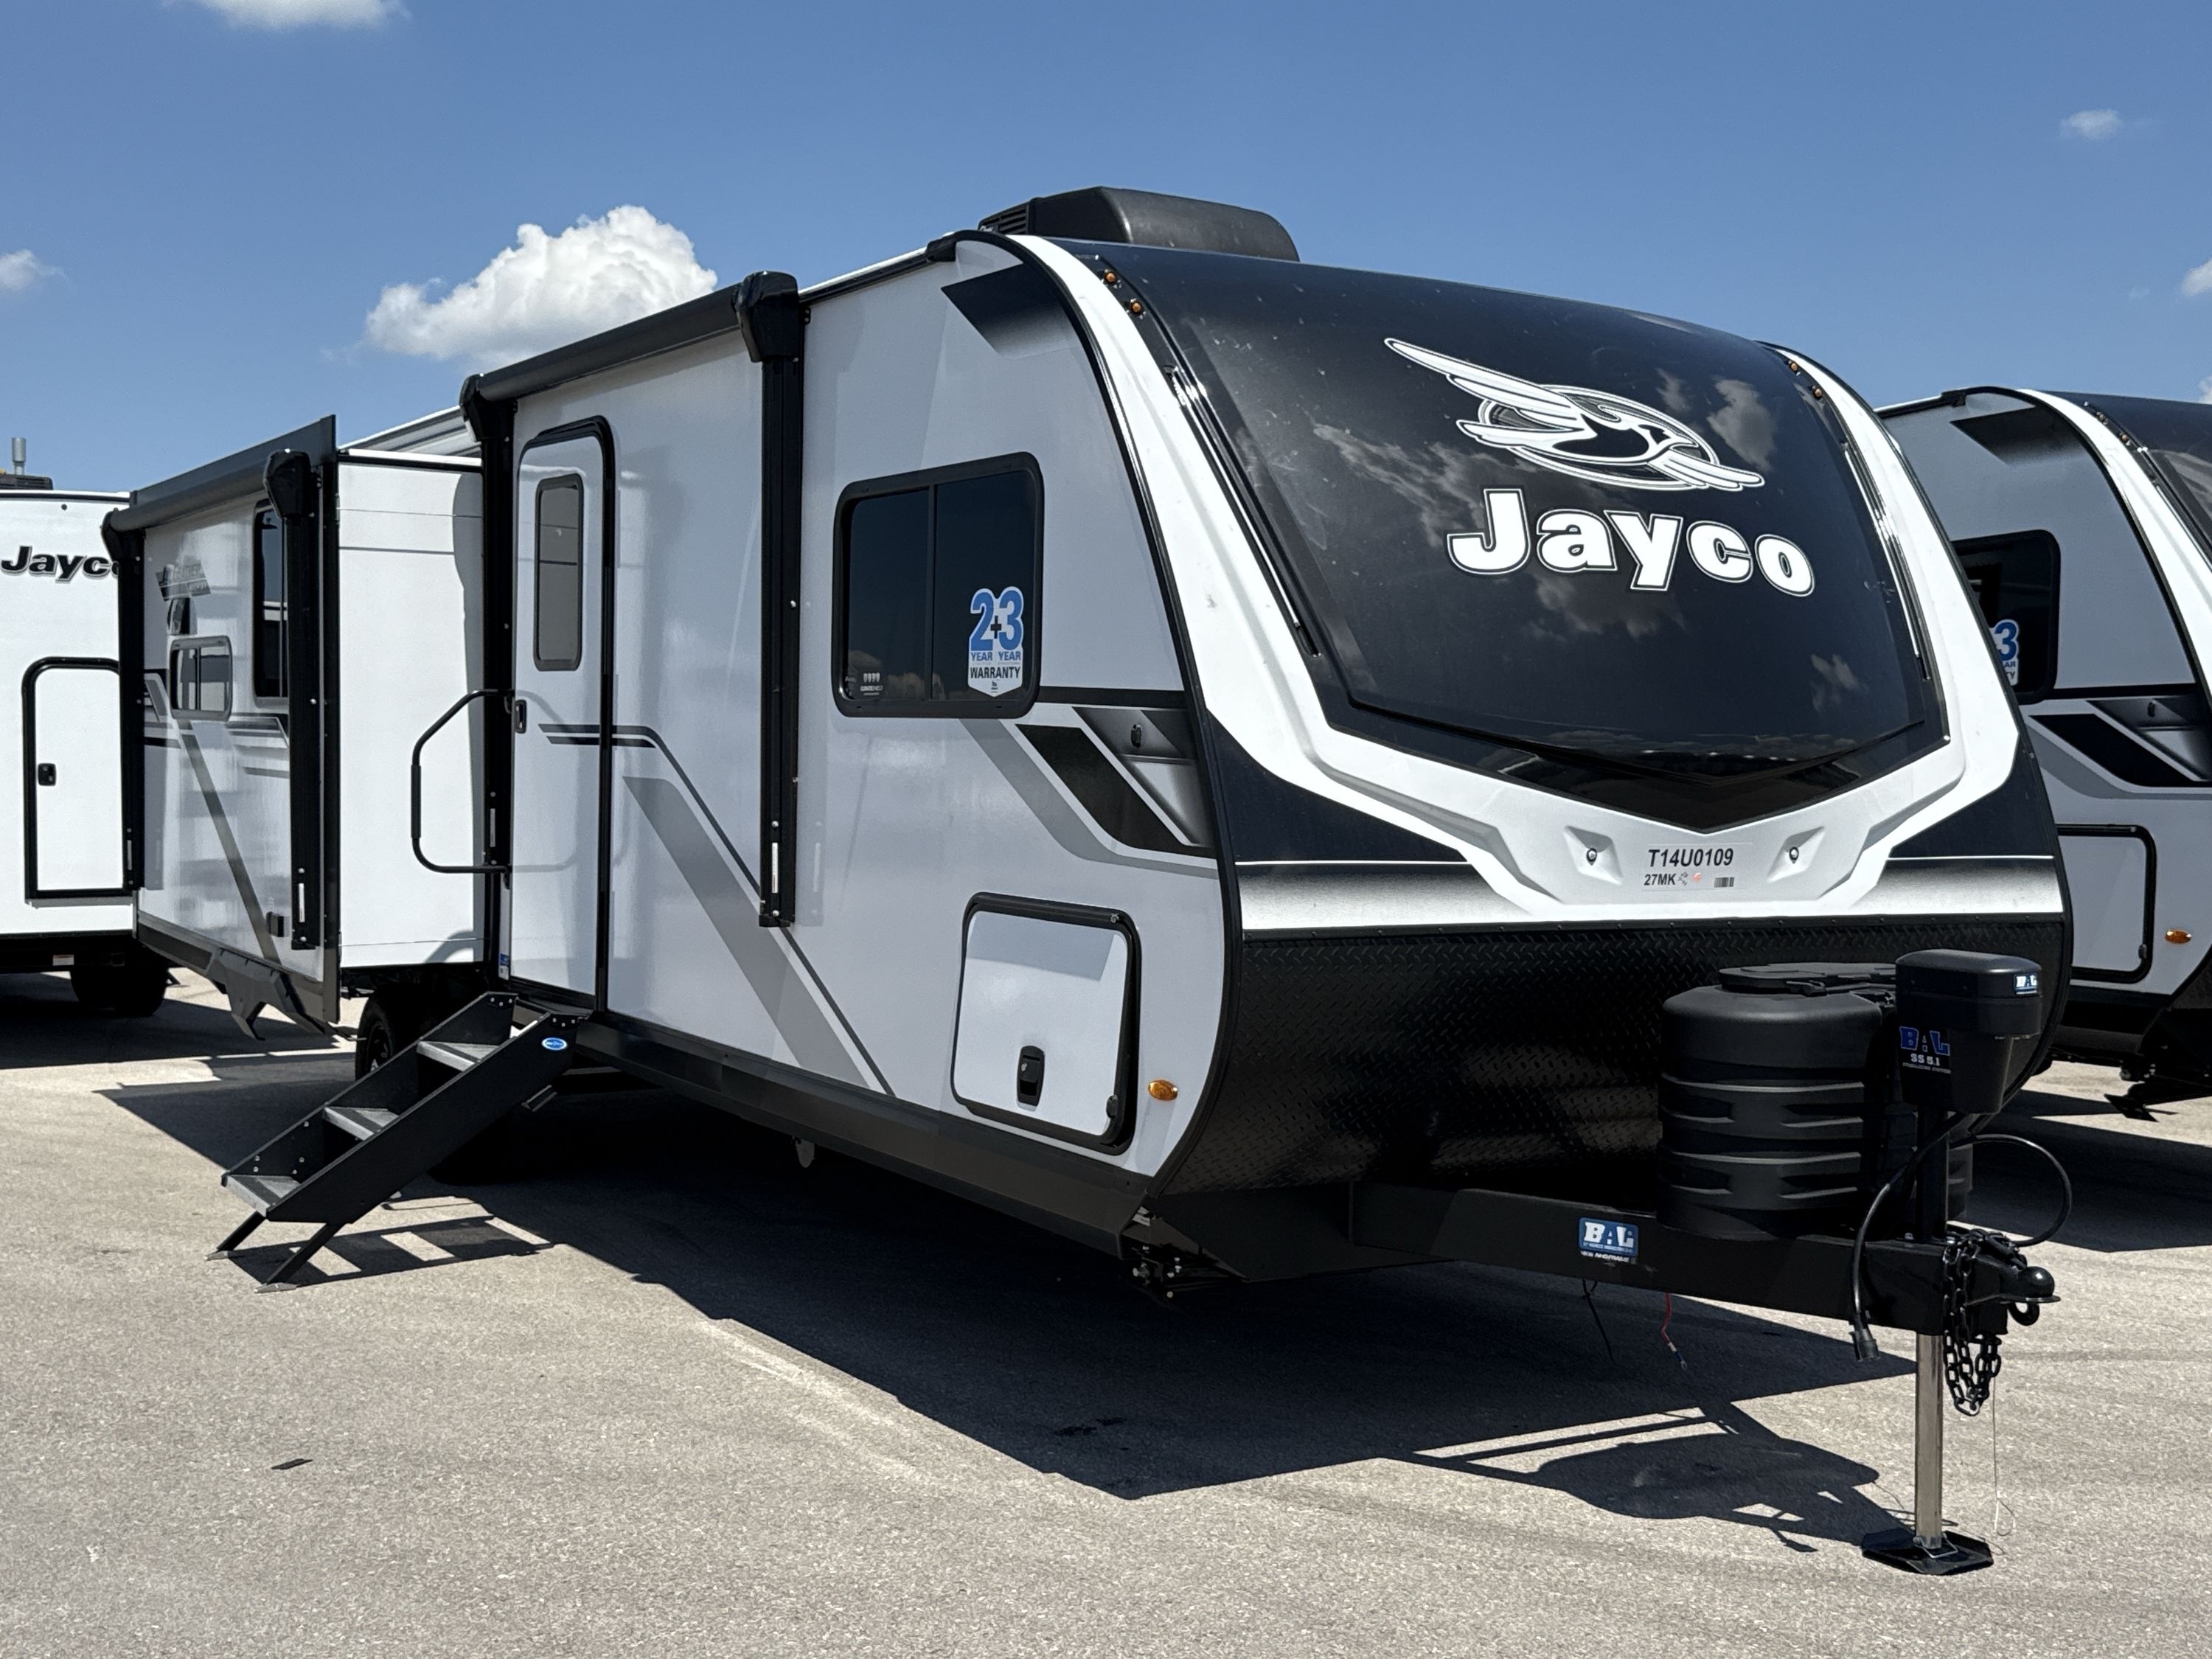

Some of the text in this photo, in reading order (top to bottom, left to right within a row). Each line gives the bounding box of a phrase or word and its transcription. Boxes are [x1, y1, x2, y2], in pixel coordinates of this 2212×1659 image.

[1447, 488, 1815, 597] Jayco
[0, 546, 119, 583] Jayc
[970, 651, 1021, 661] YEAR YEAR
[970, 667, 1021, 679] WARRANTY
[1648, 847, 1734, 868] T14U0109
[1643, 873, 1677, 886] 27MK
[1899, 1026, 1951, 1057] BAL
[1910, 1052, 1925, 1064] SS
[1583, 1221, 1635, 1249] BAL
